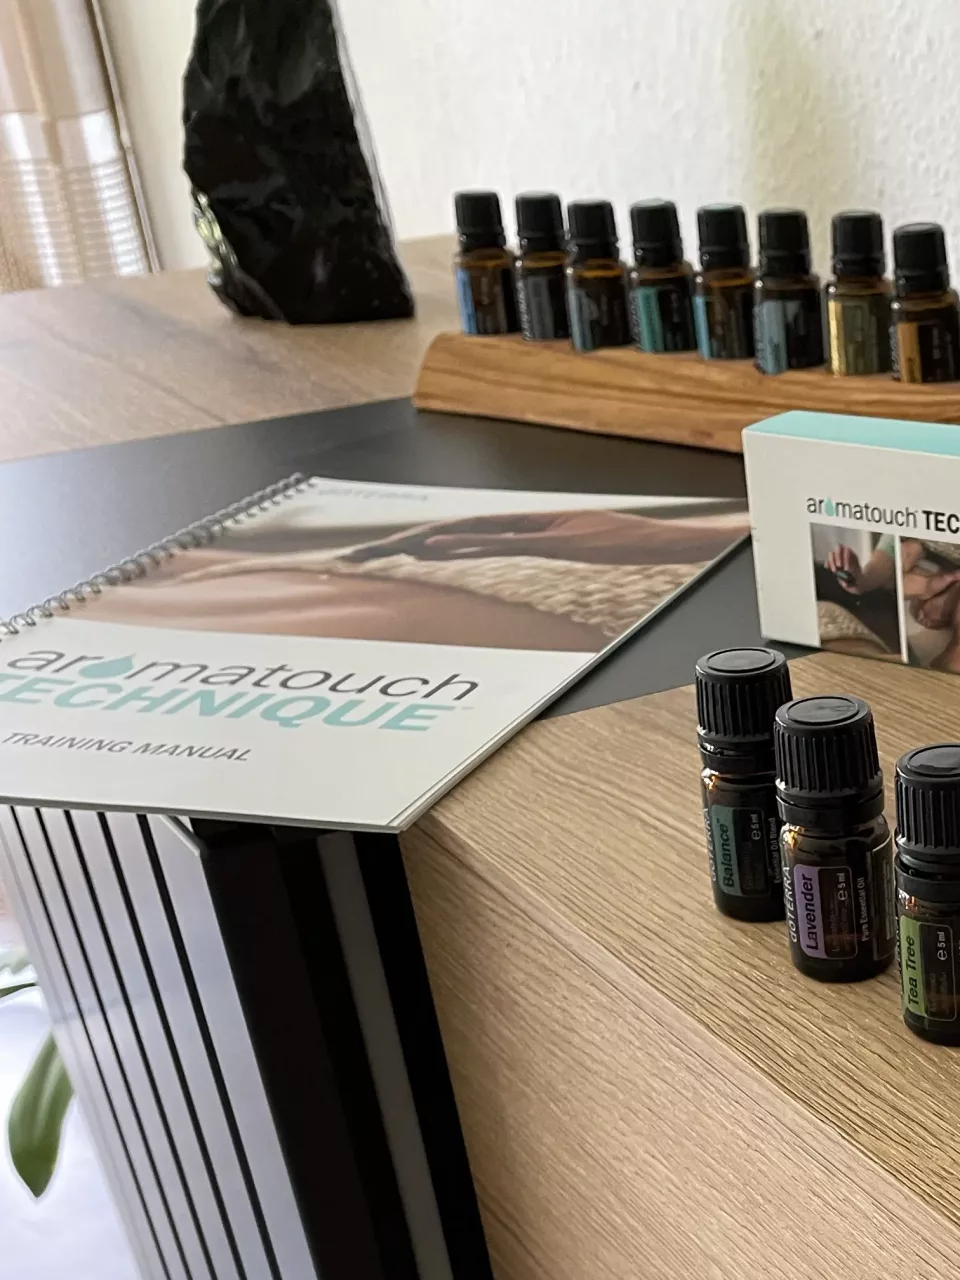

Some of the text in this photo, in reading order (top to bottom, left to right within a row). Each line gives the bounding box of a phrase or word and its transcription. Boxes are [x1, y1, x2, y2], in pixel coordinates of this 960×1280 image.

[2, 731, 252, 762] TRAINING MANUAL
[806, 874, 819, 951] Lavender
[857, 876, 870, 942] Pure Essential Oil
[937, 931, 946, 941] ml
[906, 935, 919, 1006] Tea Tree
